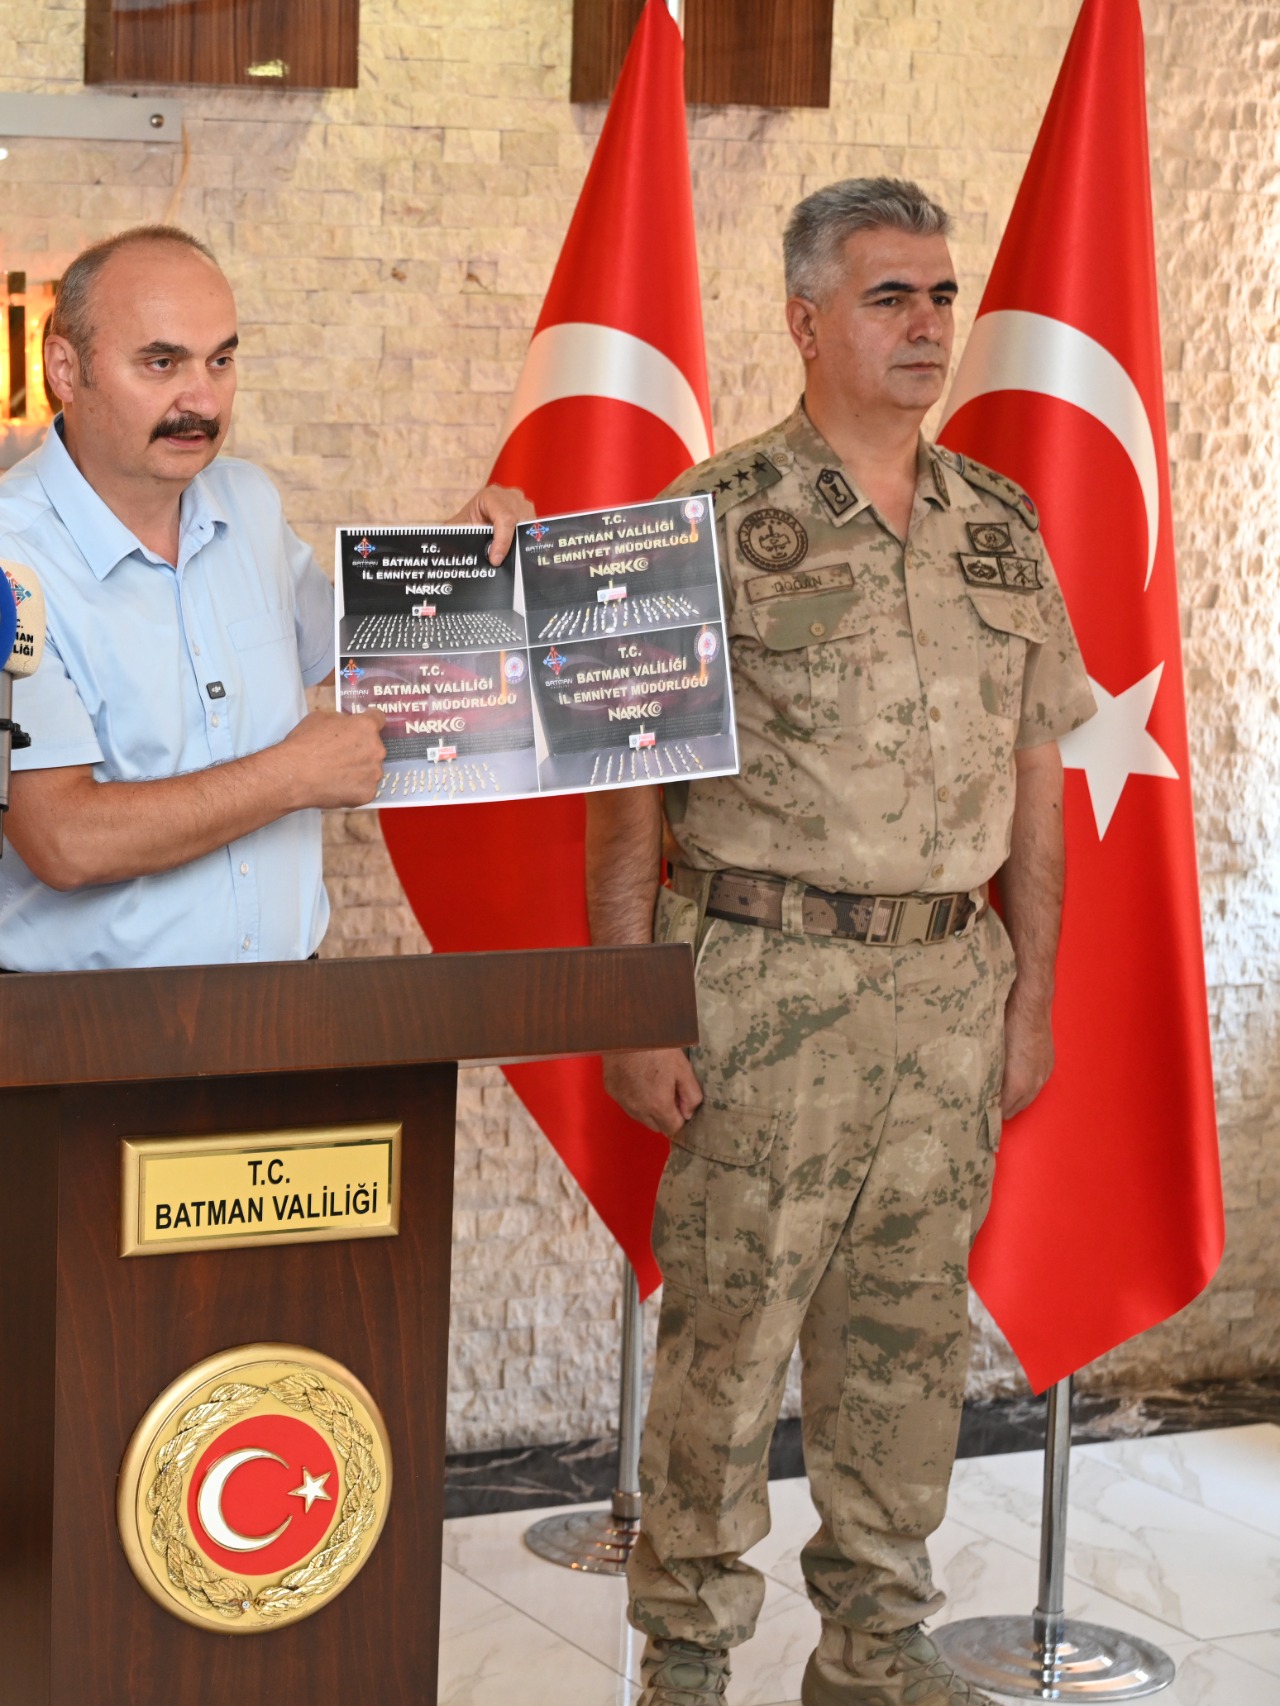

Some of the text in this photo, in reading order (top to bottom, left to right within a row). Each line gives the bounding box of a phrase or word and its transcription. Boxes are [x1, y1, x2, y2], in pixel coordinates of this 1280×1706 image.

[601, 514, 627, 526] T.C.
[558, 520, 674, 548] BATMAN VALİLİĞİ
[420, 543, 441, 554] T.C.
[382, 555, 478, 567] BATMAN VALİLİĞİ
[618, 645, 642, 659] T.C.
[419, 665, 445, 677] T.C.
[576, 656, 687, 685] BATMAN VALİLİĞİ
[373, 677, 494, 696] BATMAN VALİLİĞİ
[247, 1158, 291, 1186] T.C.
[155, 1181, 378, 1230] BATMAN VALİLİĞİ
